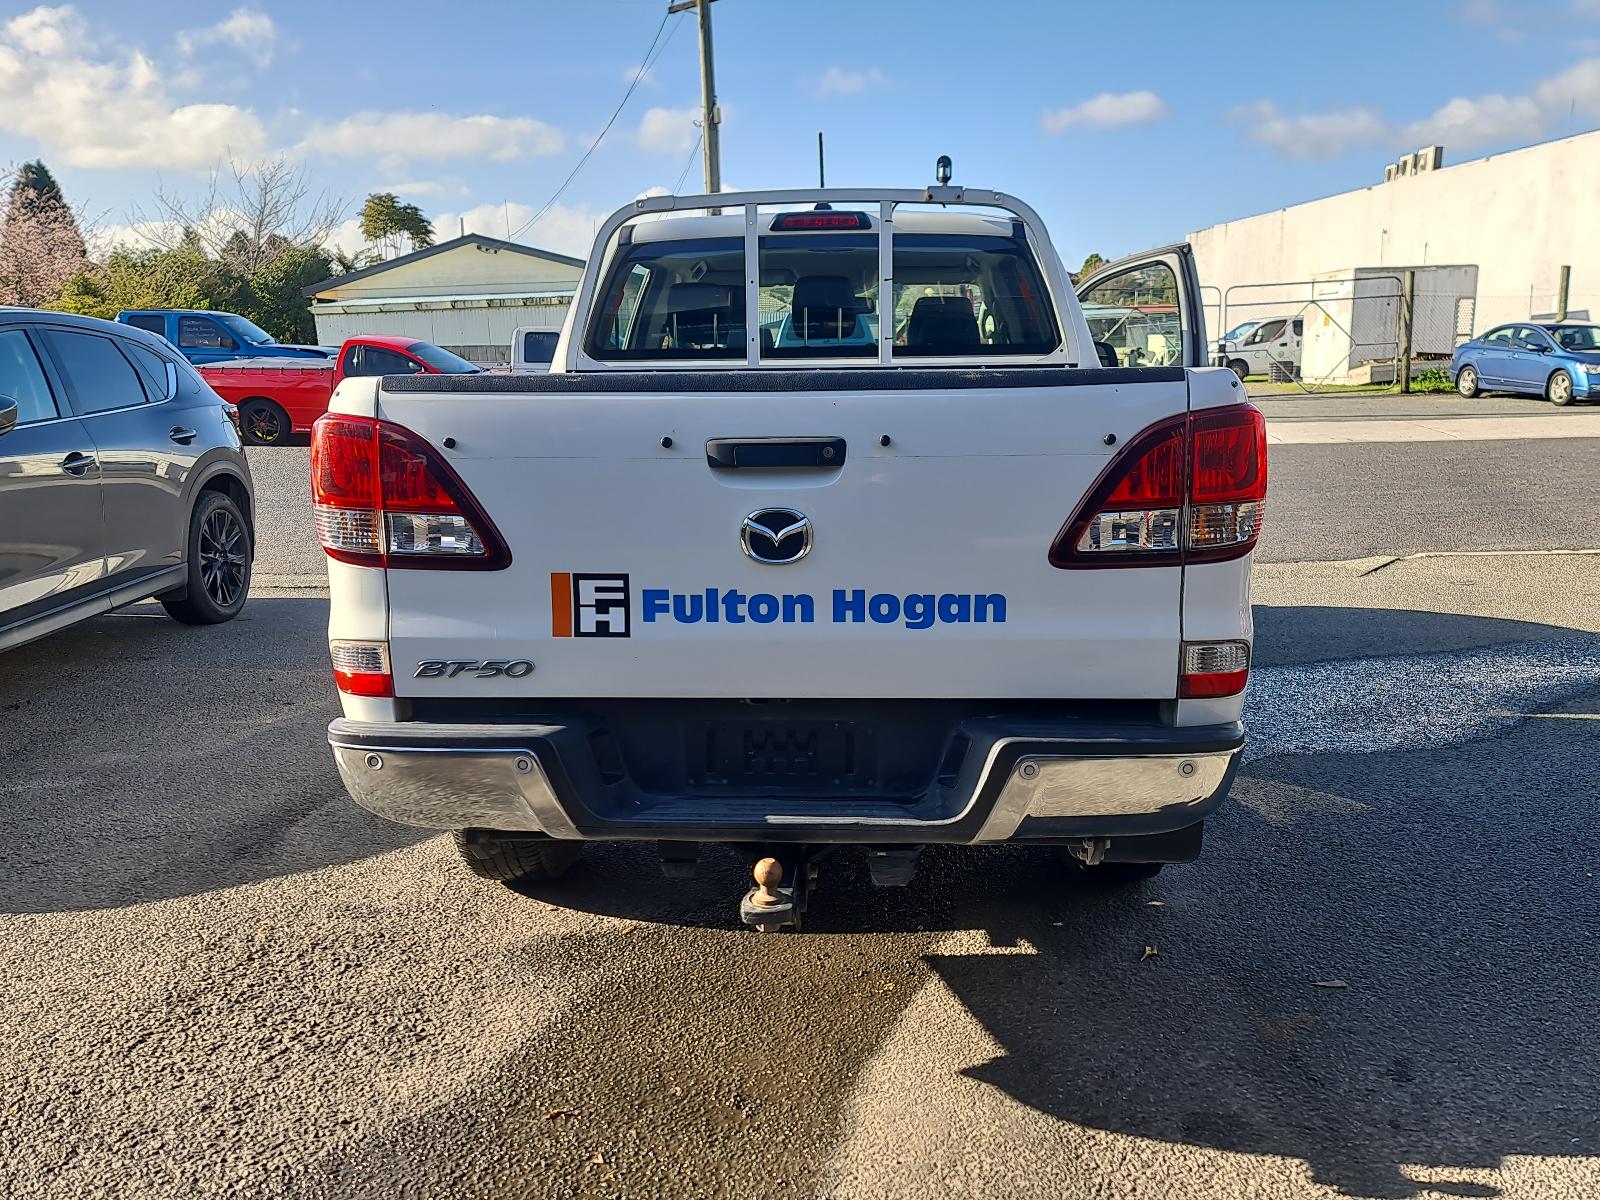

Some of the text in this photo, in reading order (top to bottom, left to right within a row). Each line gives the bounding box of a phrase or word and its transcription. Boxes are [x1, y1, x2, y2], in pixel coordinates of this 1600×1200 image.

[642, 588, 1007, 630] Fulton Hogan
[413, 659, 536, 678] BT-50
